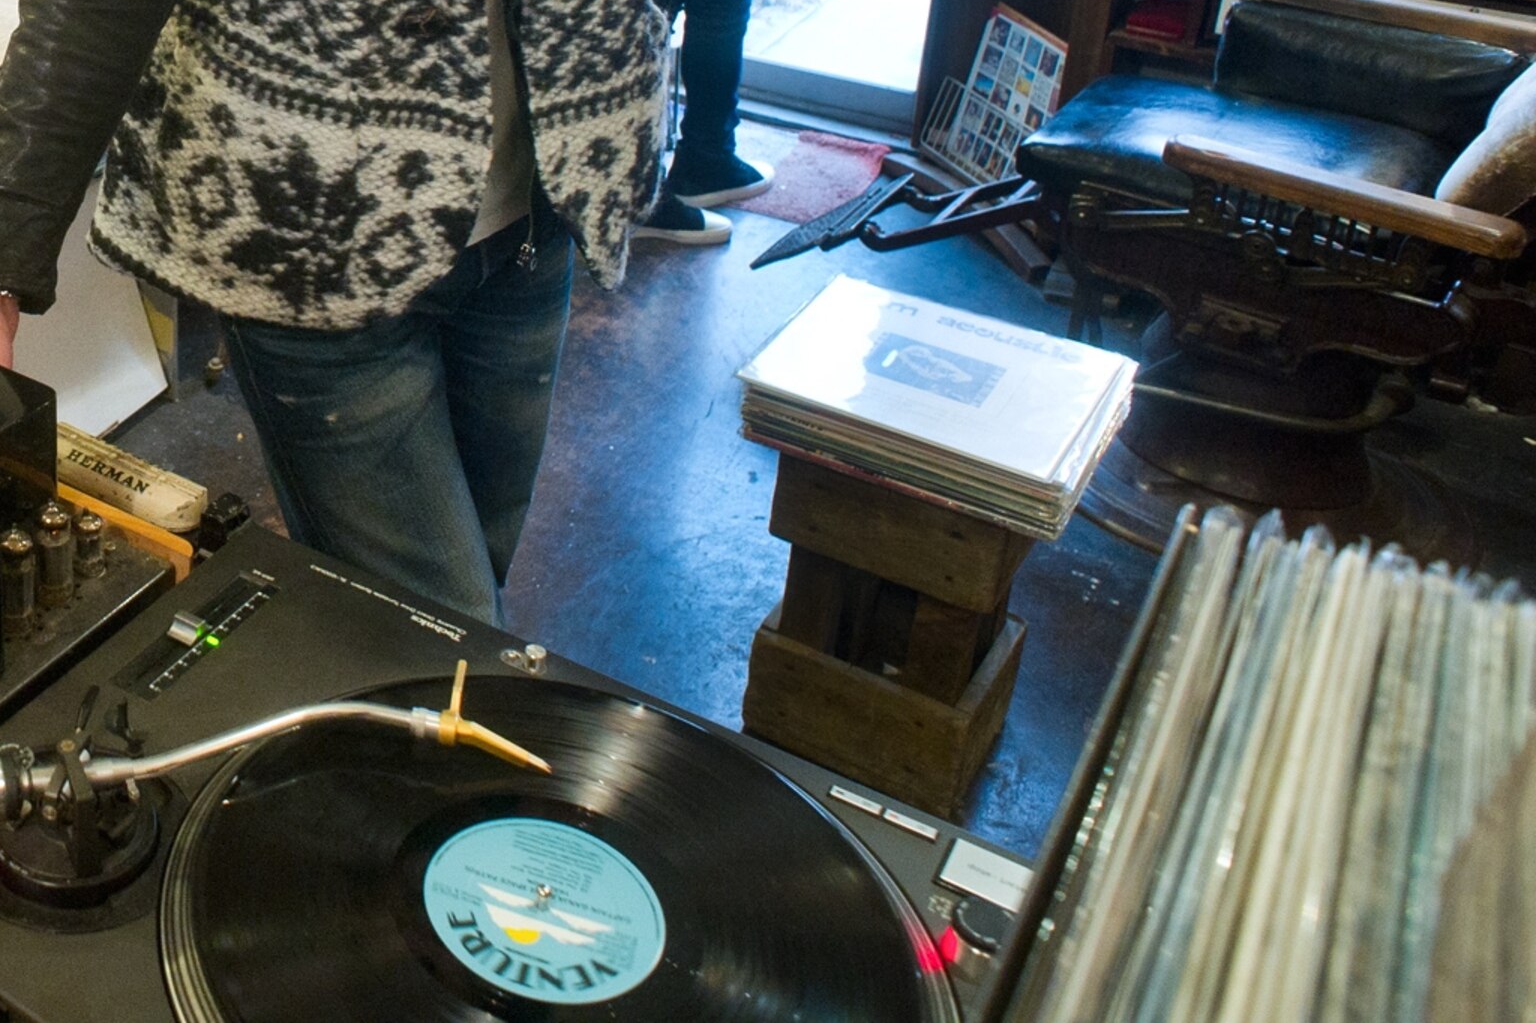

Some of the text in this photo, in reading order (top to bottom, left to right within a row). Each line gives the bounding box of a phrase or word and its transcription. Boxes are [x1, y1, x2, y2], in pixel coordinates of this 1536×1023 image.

[936, 314, 1083, 363] acoustic
[66, 449, 150, 494] HERMAN
[410, 614, 462, 643] Technics
[446, 909, 619, 993] VENTURE
